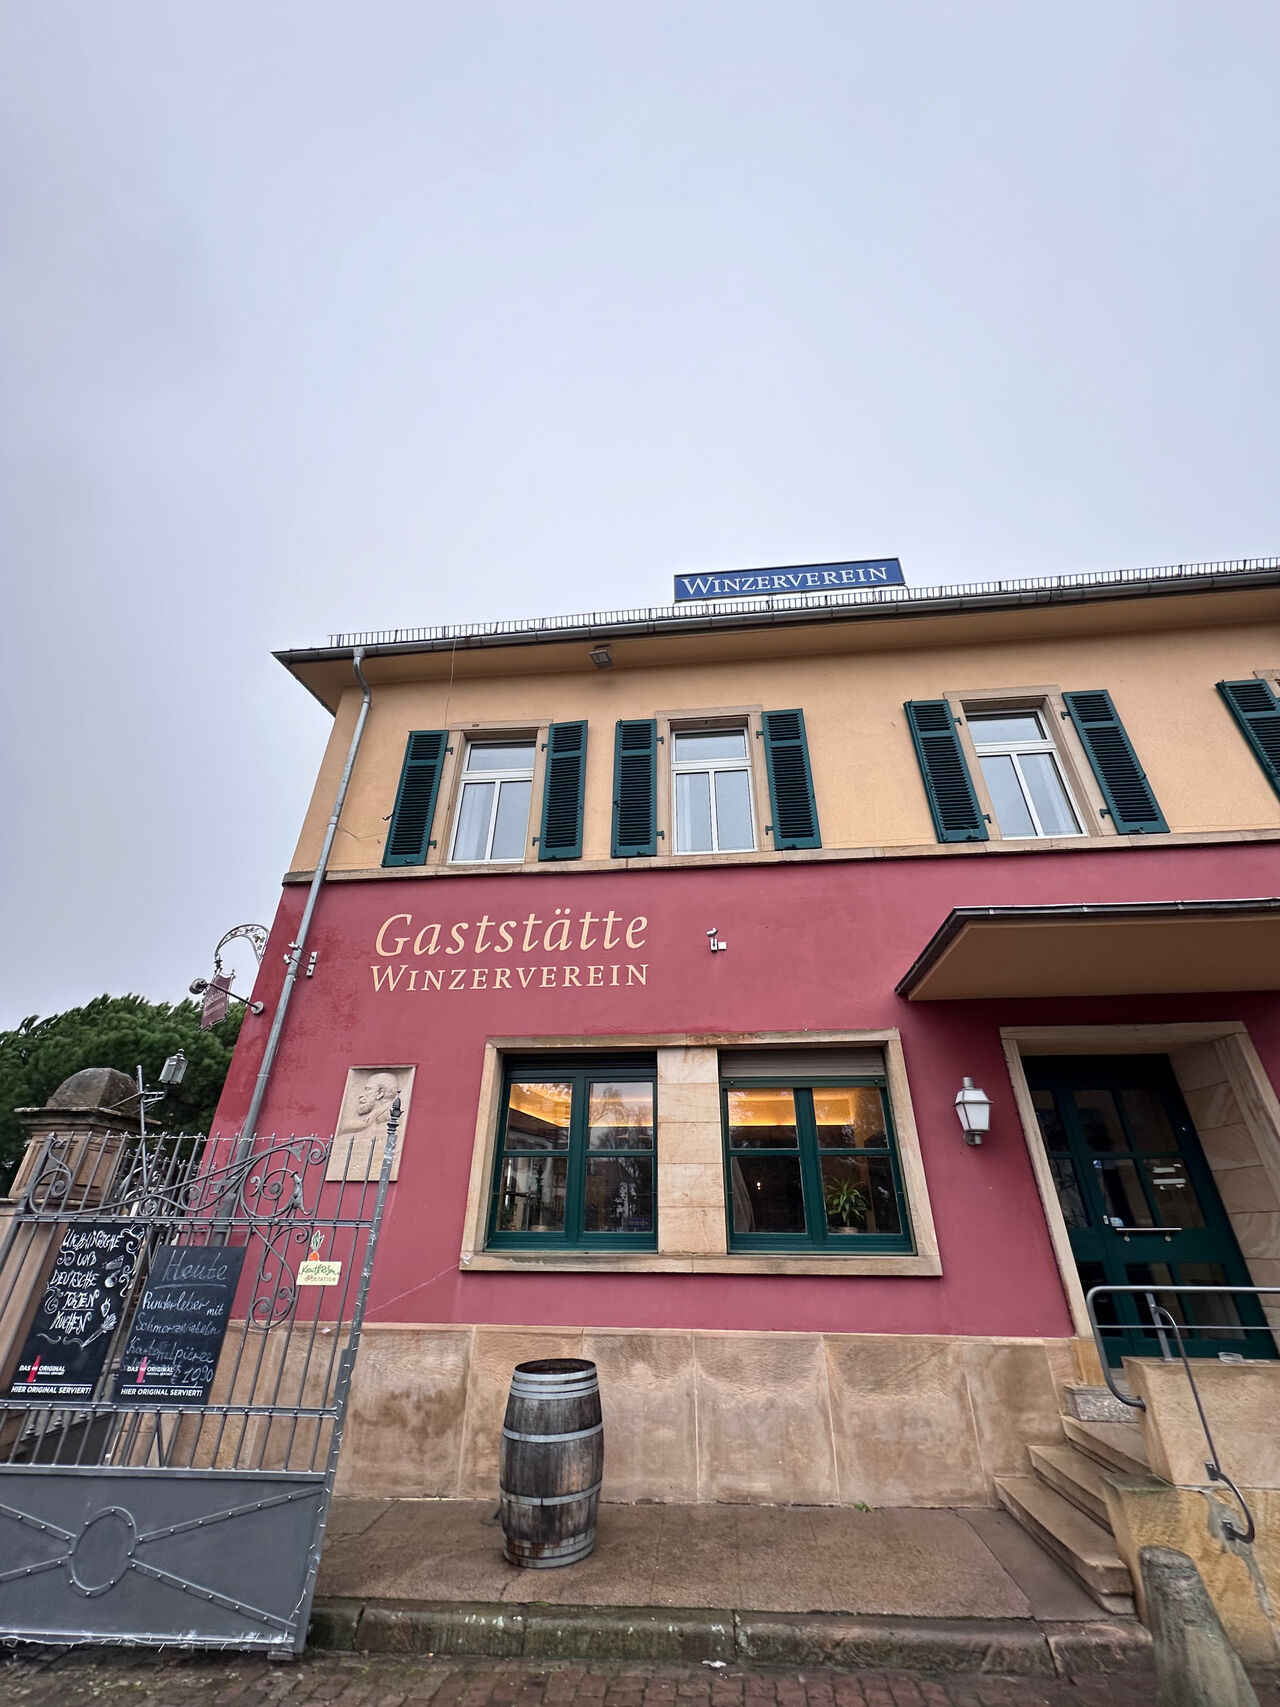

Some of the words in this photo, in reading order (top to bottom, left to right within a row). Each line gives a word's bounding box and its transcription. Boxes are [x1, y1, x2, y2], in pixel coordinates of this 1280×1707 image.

[681, 567, 887, 596] WINZERVEREIN
[375, 907, 649, 957] Gaststätte
[370, 963, 649, 992] WINZERVEREIN
[161, 1249, 228, 1281] Heute
[206, 1303, 224, 1316] mit
[10, 1385, 27, 1393] HIER
[27, 1386, 57, 1394] ORIGINAL
[170, 1389, 203, 1397] SERVIERT!
